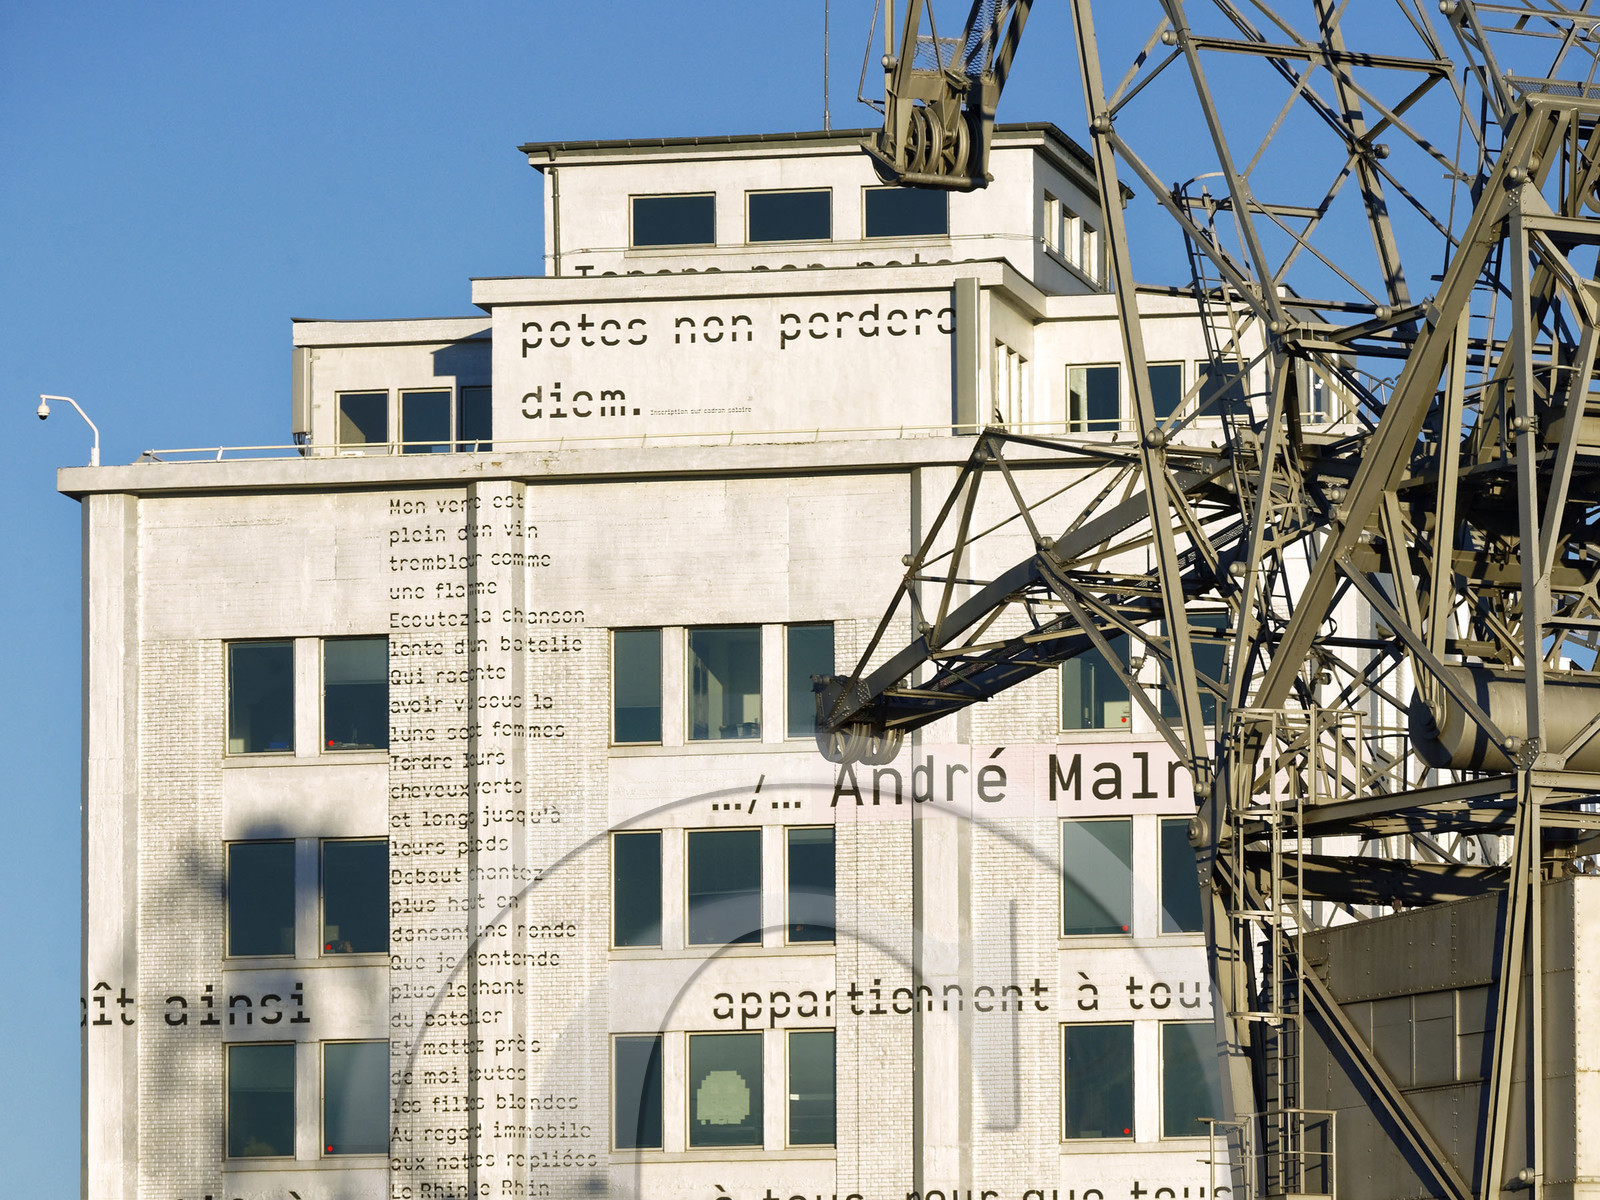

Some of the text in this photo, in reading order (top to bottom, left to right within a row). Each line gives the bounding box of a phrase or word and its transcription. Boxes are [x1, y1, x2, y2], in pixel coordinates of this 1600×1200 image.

[522, 313, 647, 357] potes
[675, 313, 753, 344] non
[522, 382, 640, 419] diem.
[831, 747, 1007, 807] André
[165, 982, 310, 1026] ainsi
[1077, 972, 1098, 1010] à
[1127, 976, 1217, 1010] tou
